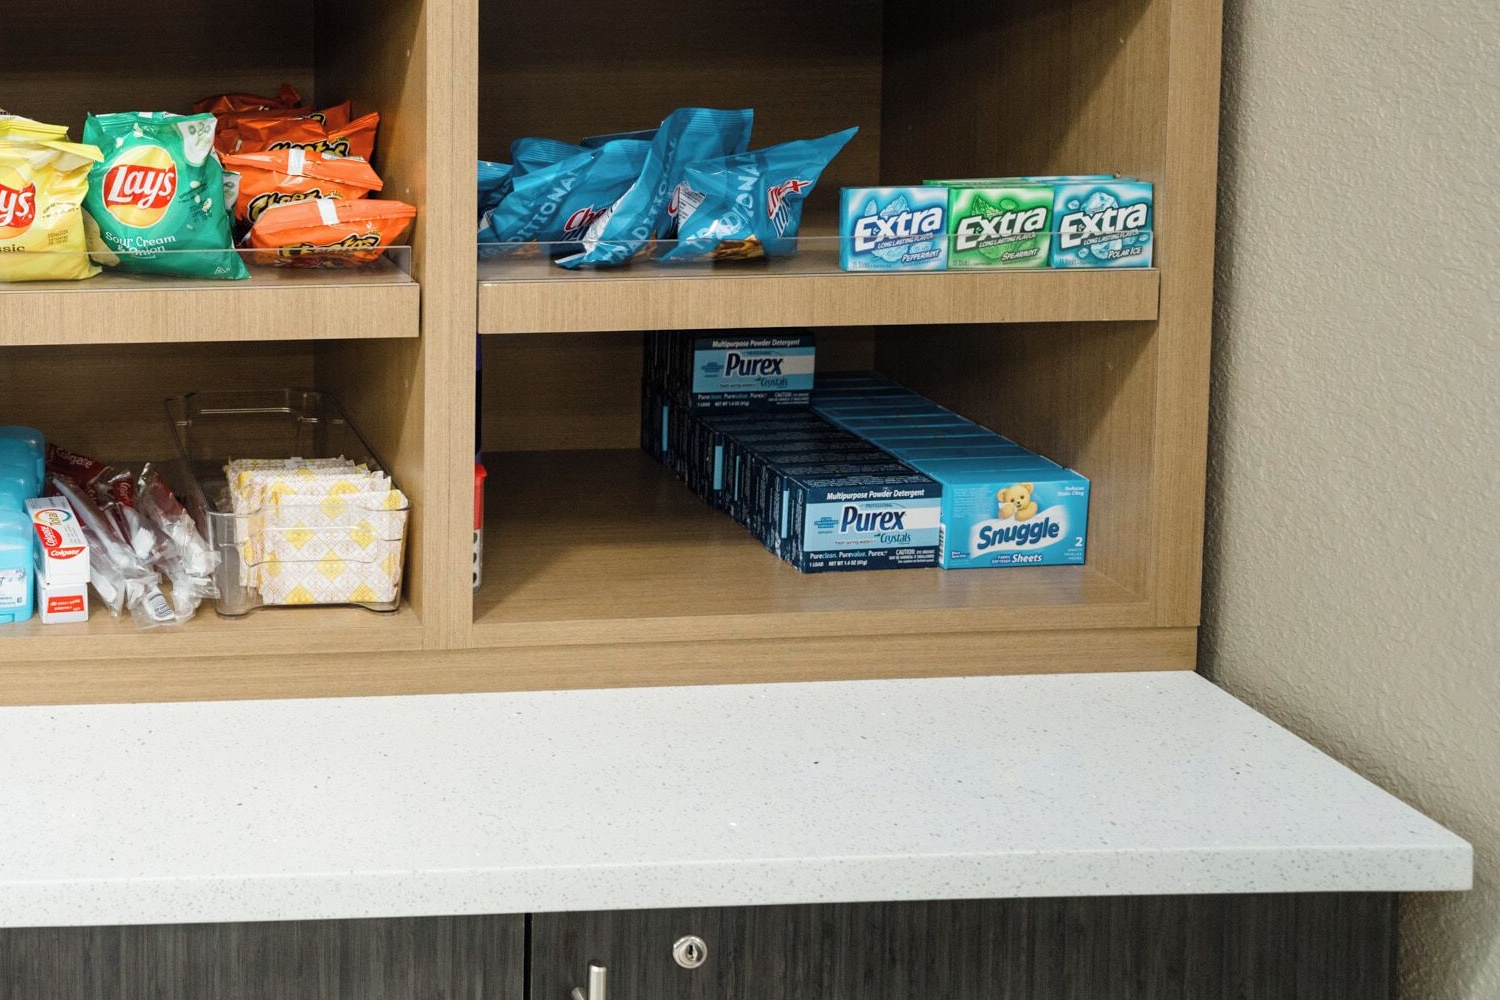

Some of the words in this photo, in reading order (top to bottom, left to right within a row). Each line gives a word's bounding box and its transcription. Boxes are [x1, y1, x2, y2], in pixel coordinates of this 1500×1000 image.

[107, 166, 175, 209] Lay's
[854, 207, 943, 252] Extra
[956, 207, 1047, 251] Extra
[1060, 203, 1148, 250] Extra
[105, 231, 133, 249] Sour
[135, 234, 177, 248] Cream
[877, 241, 892, 249] LONG
[892, 237, 912, 246] LASTING
[912, 233, 934, 243] FLAVOR
[979, 240, 994, 249] LONG
[994, 236, 1015, 246] LASTING
[1015, 232, 1036, 242] FLAVOR
[1083, 237, 1097, 246] LONG
[1097, 233, 1119, 242] LASTING
[1119, 229, 1140, 238] FLAVOR
[128, 245, 166, 257] Onion
[902, 249, 941, 262] PEPPERMINT
[1002, 248, 1039, 262] SPEARMINT
[1107, 248, 1130, 259] POLAR
[1130, 246, 1142, 256] ICE
[712, 340, 749, 348] Multipurpose
[750, 339, 771, 347] Powder
[771, 339, 800, 347] Detergent
[725, 352, 784, 377] Purex
[56, 447, 93, 469] Colgate
[826, 492, 868, 501] Multipurpose
[868, 490, 893, 498] Powder
[893, 489, 925, 498] Detergent
[840, 505, 906, 533] Purex
[41, 525, 58, 547] Colgate
[880, 533, 911, 544] Crystals
[977, 517, 1060, 550] Snuggle
[1075, 536, 1083, 547] 2
[50, 549, 81, 557] Colgate
[1011, 553, 1043, 564] Sheets
